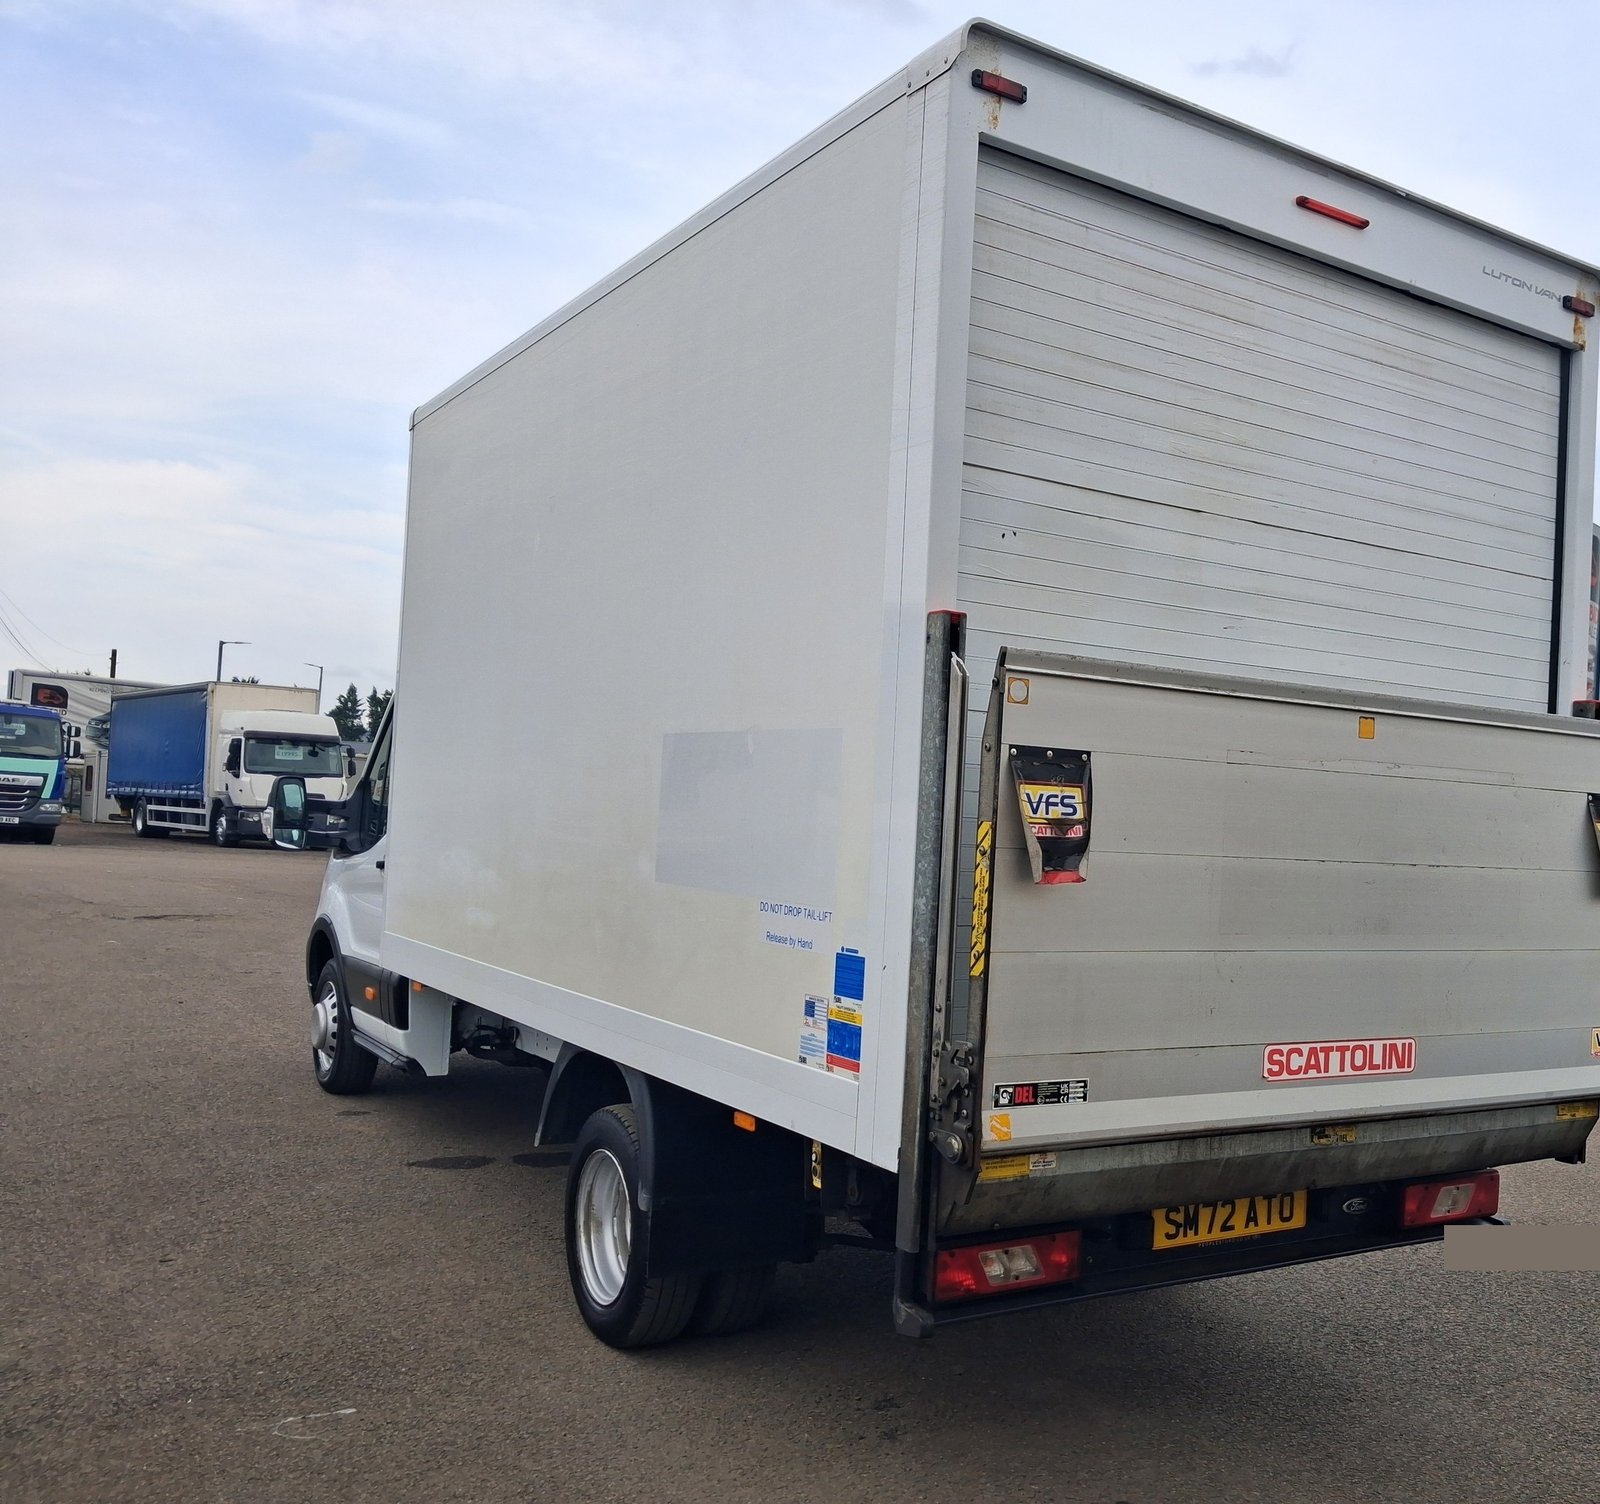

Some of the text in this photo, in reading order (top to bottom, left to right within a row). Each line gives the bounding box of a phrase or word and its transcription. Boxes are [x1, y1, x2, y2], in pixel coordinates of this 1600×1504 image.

[1482, 265, 1562, 302] LUTON VAN
[1025, 792, 1078, 817] VFS
[760, 901, 832, 923] DO NOT DROP TAIL-LIFT
[766, 930, 813, 950] Release by Hand
[1266, 1042, 1413, 1077] SCATTOLINI
[1014, 1086, 1035, 1104] DEL
[1164, 1192, 1294, 1240] SM72 ATO
